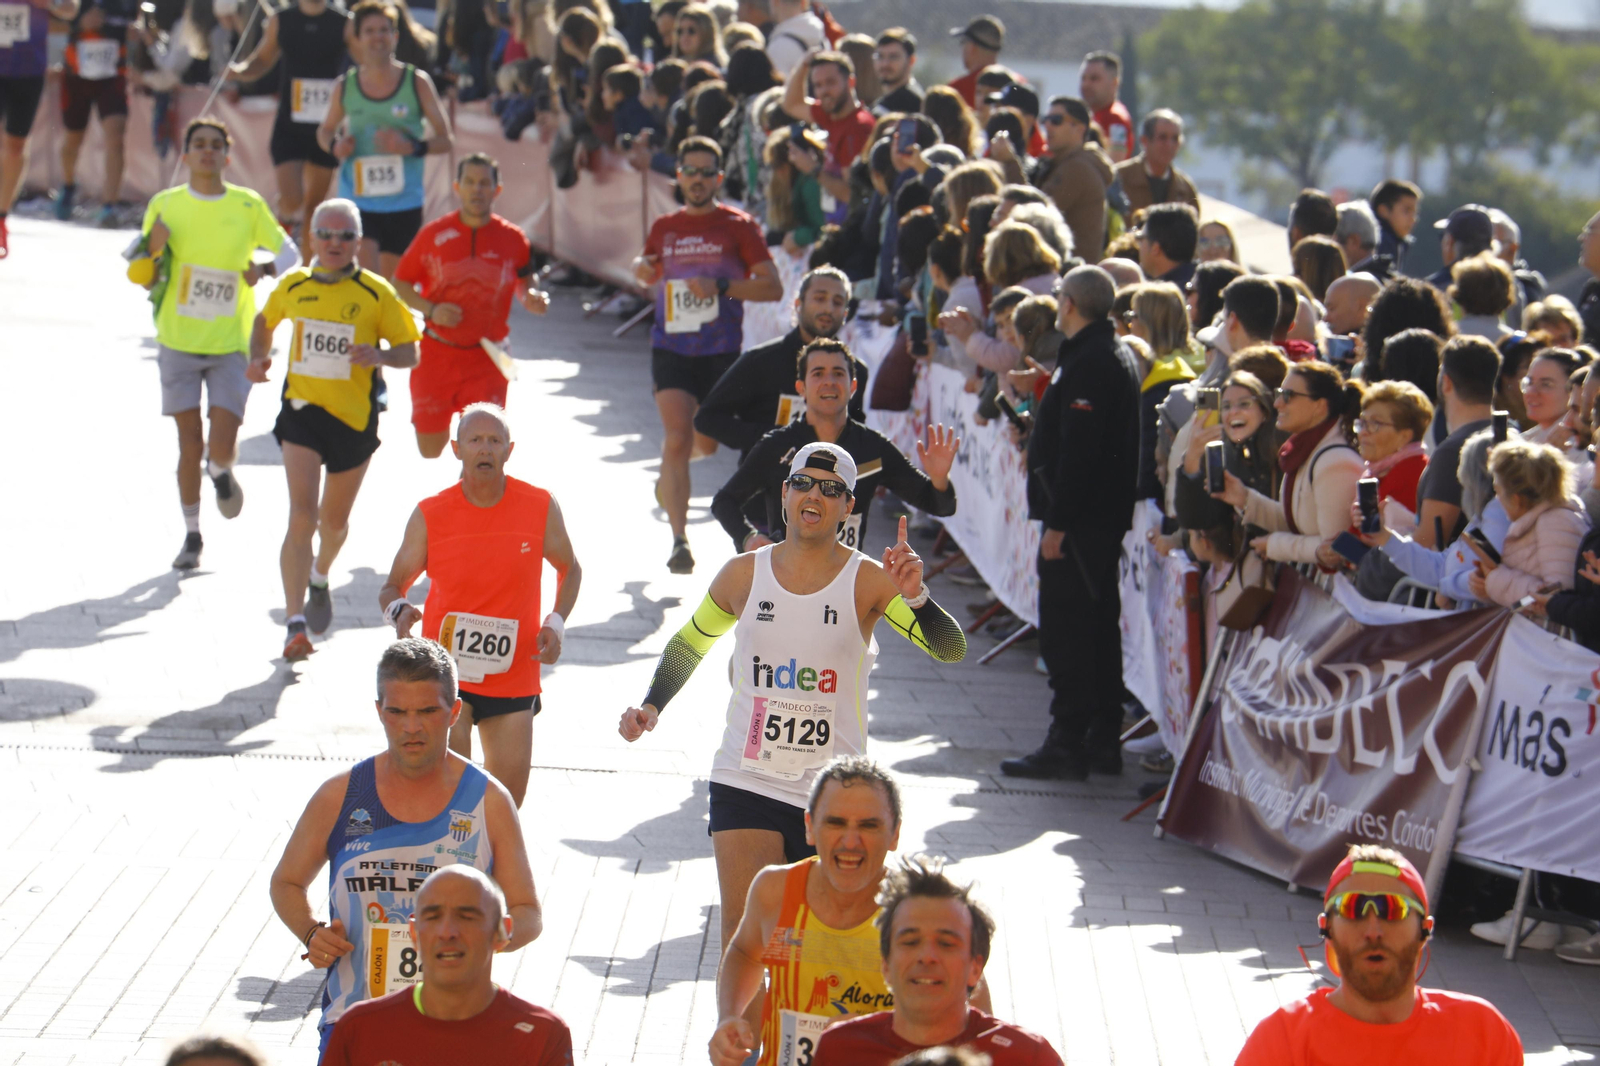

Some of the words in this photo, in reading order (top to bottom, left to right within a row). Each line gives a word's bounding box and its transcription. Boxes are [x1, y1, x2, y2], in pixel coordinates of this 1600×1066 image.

[193, 279, 235, 303] 5670
[305, 331, 349, 355] 1666
[465, 617, 495, 628] IMDECO
[455, 628, 511, 657] 1260
[753, 655, 838, 693] indea
[777, 700, 812, 713] IMDECO
[751, 719, 761, 745] CAJÓN
[764, 713, 830, 747] 5129
[1487, 684, 1572, 777] Más
[359, 861, 441, 874] ATLETISM
[446, 847, 478, 862] cajamar
[374, 954, 383, 984] CAJÓN
[839, 981, 895, 1008] Álora
